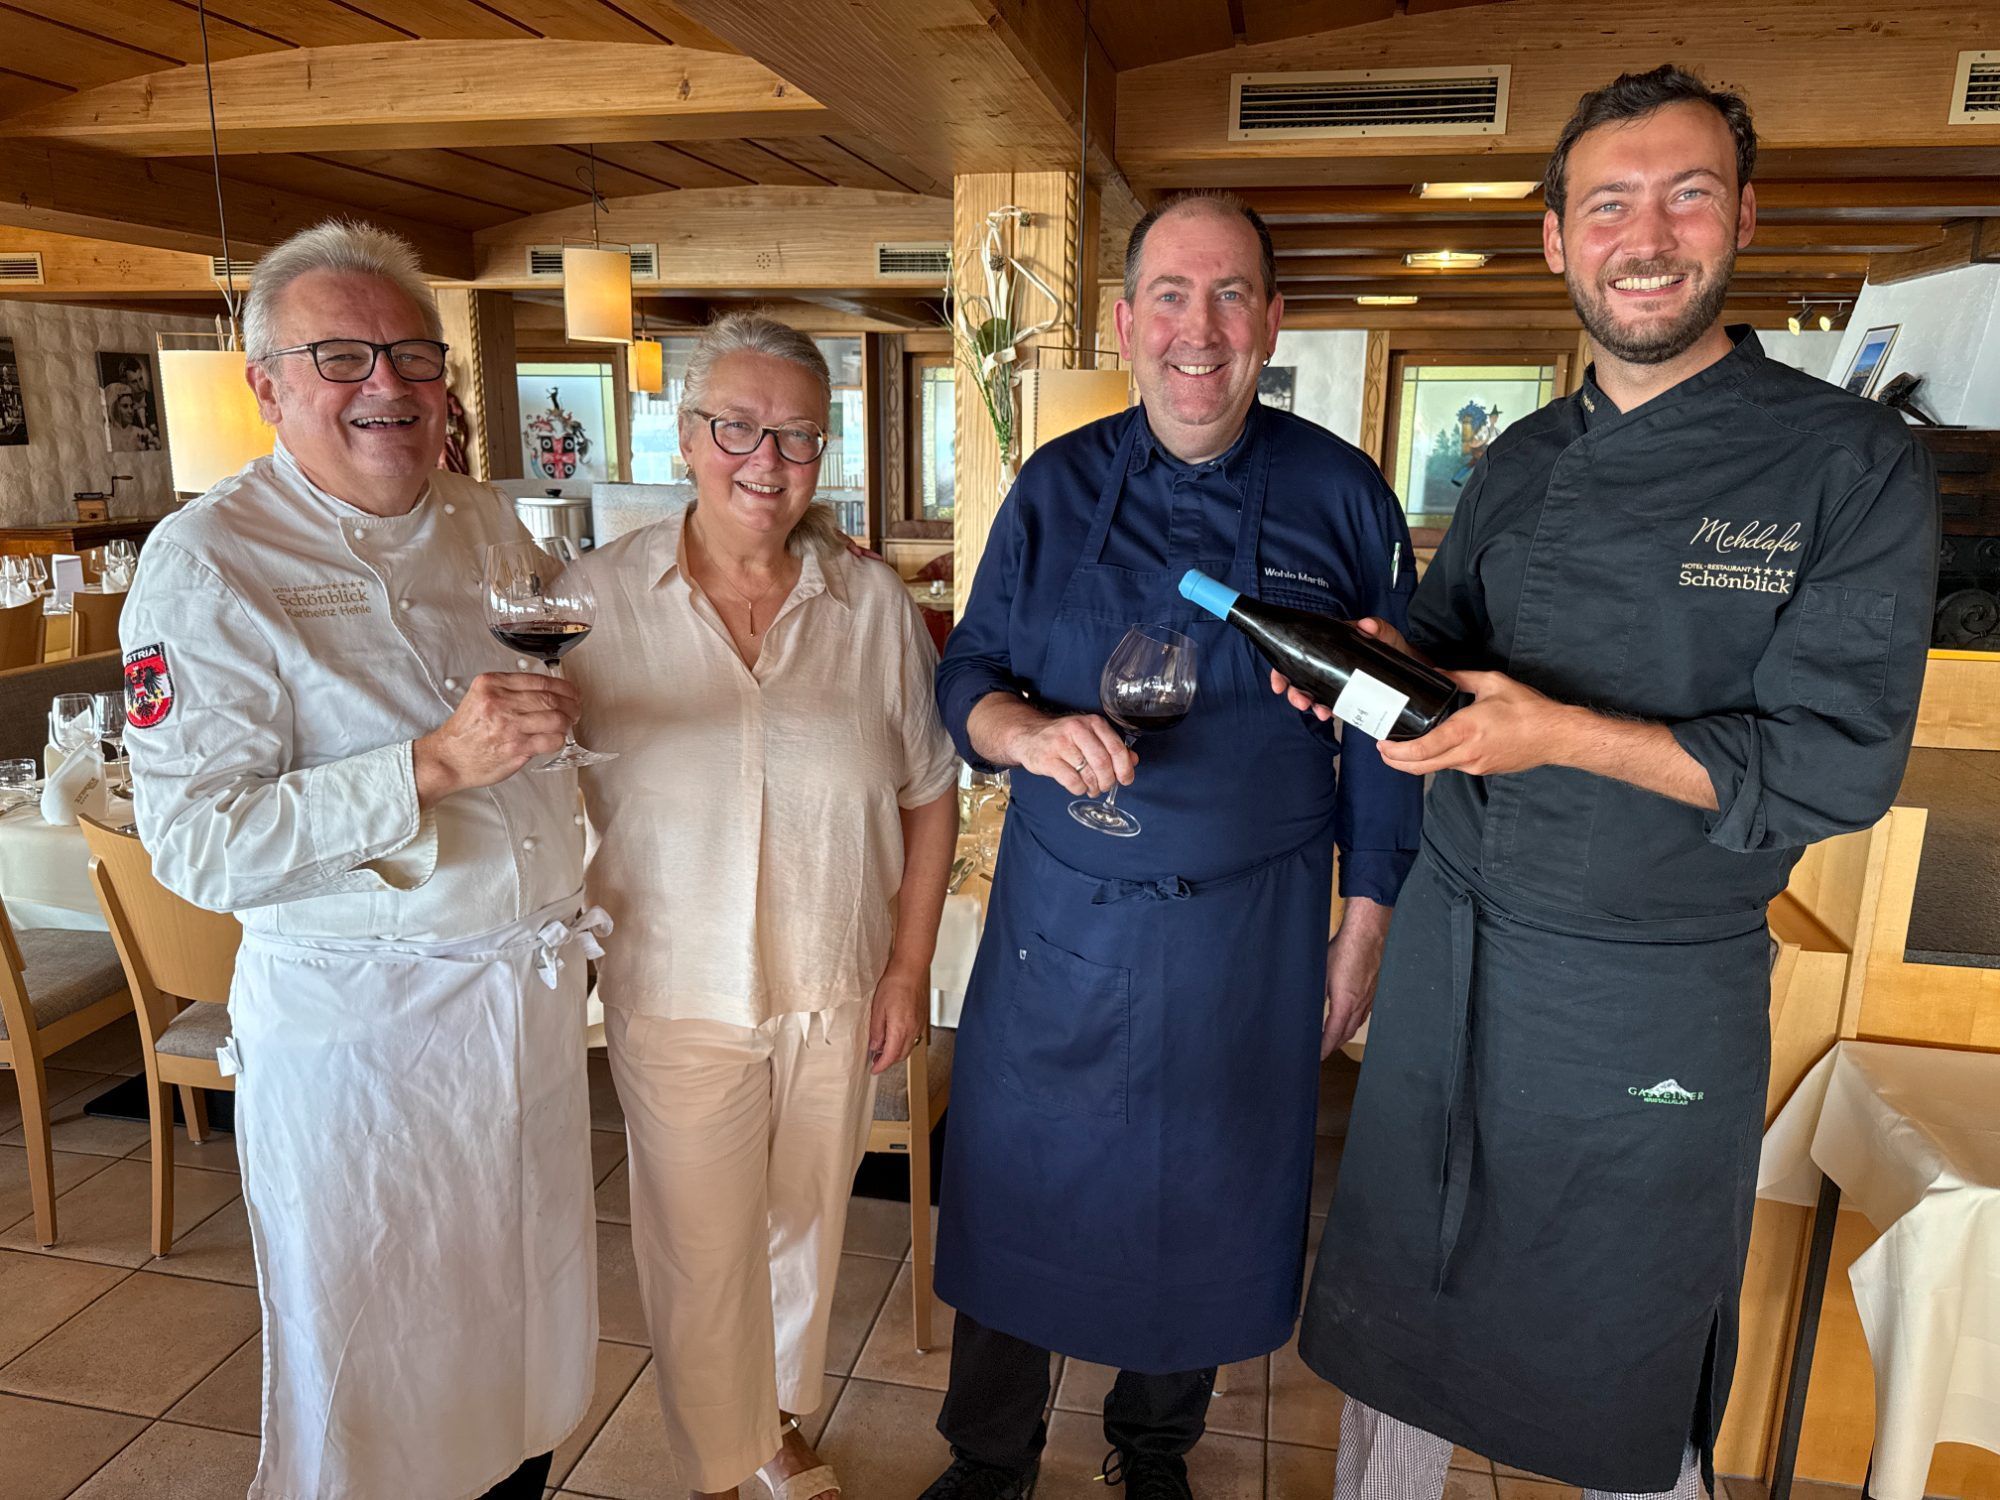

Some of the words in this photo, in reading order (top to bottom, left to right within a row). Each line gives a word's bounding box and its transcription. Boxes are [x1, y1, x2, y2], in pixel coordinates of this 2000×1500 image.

[1298, 572, 1330, 589] Martin
[1679, 570, 1792, 595] Schönblick
[276, 589, 370, 607] Schönblick
[283, 606, 337, 619] Karlheinz
[340, 604, 372, 616] Hehle
[126, 647, 158, 664] STRIA
